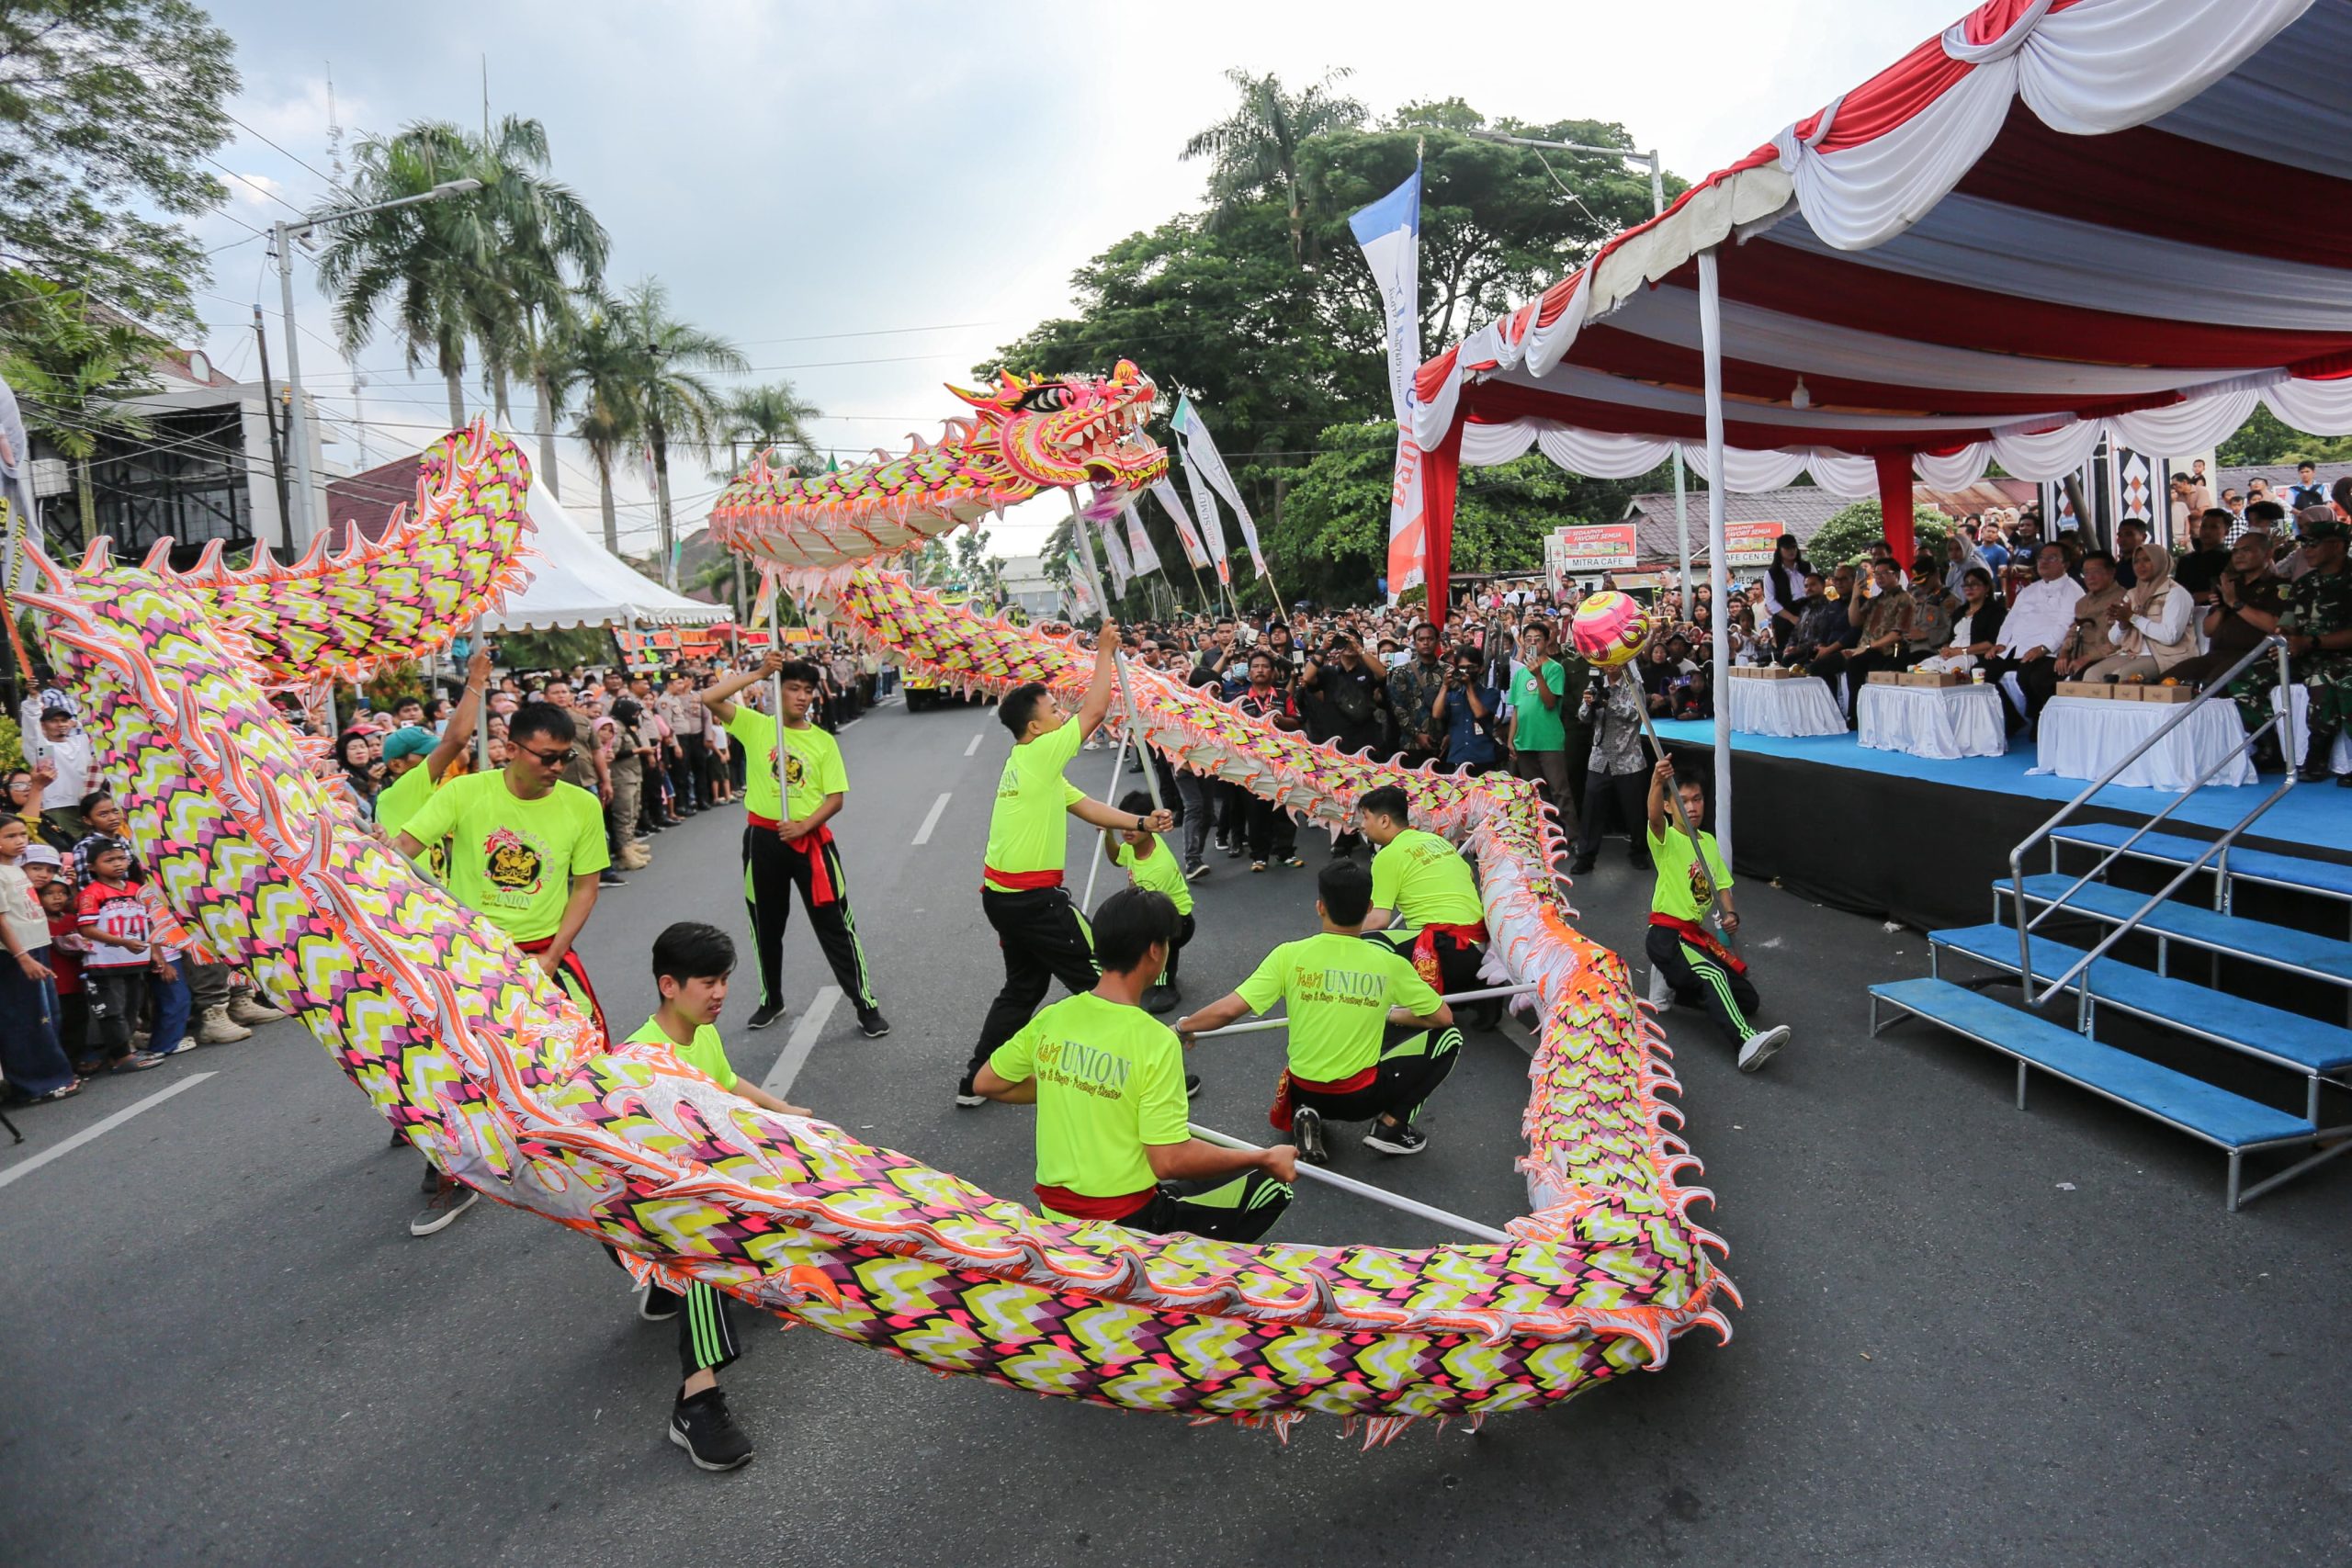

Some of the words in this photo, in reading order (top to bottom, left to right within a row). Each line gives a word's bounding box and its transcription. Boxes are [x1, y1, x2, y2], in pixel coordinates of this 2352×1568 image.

[1572, 558, 1599, 567] MITRA
[1600, 558, 1623, 566] CAFE
[496, 893, 530, 907] UNION
[1324, 968, 1387, 999] UNION
[1060, 1040, 1132, 1089] UNION
